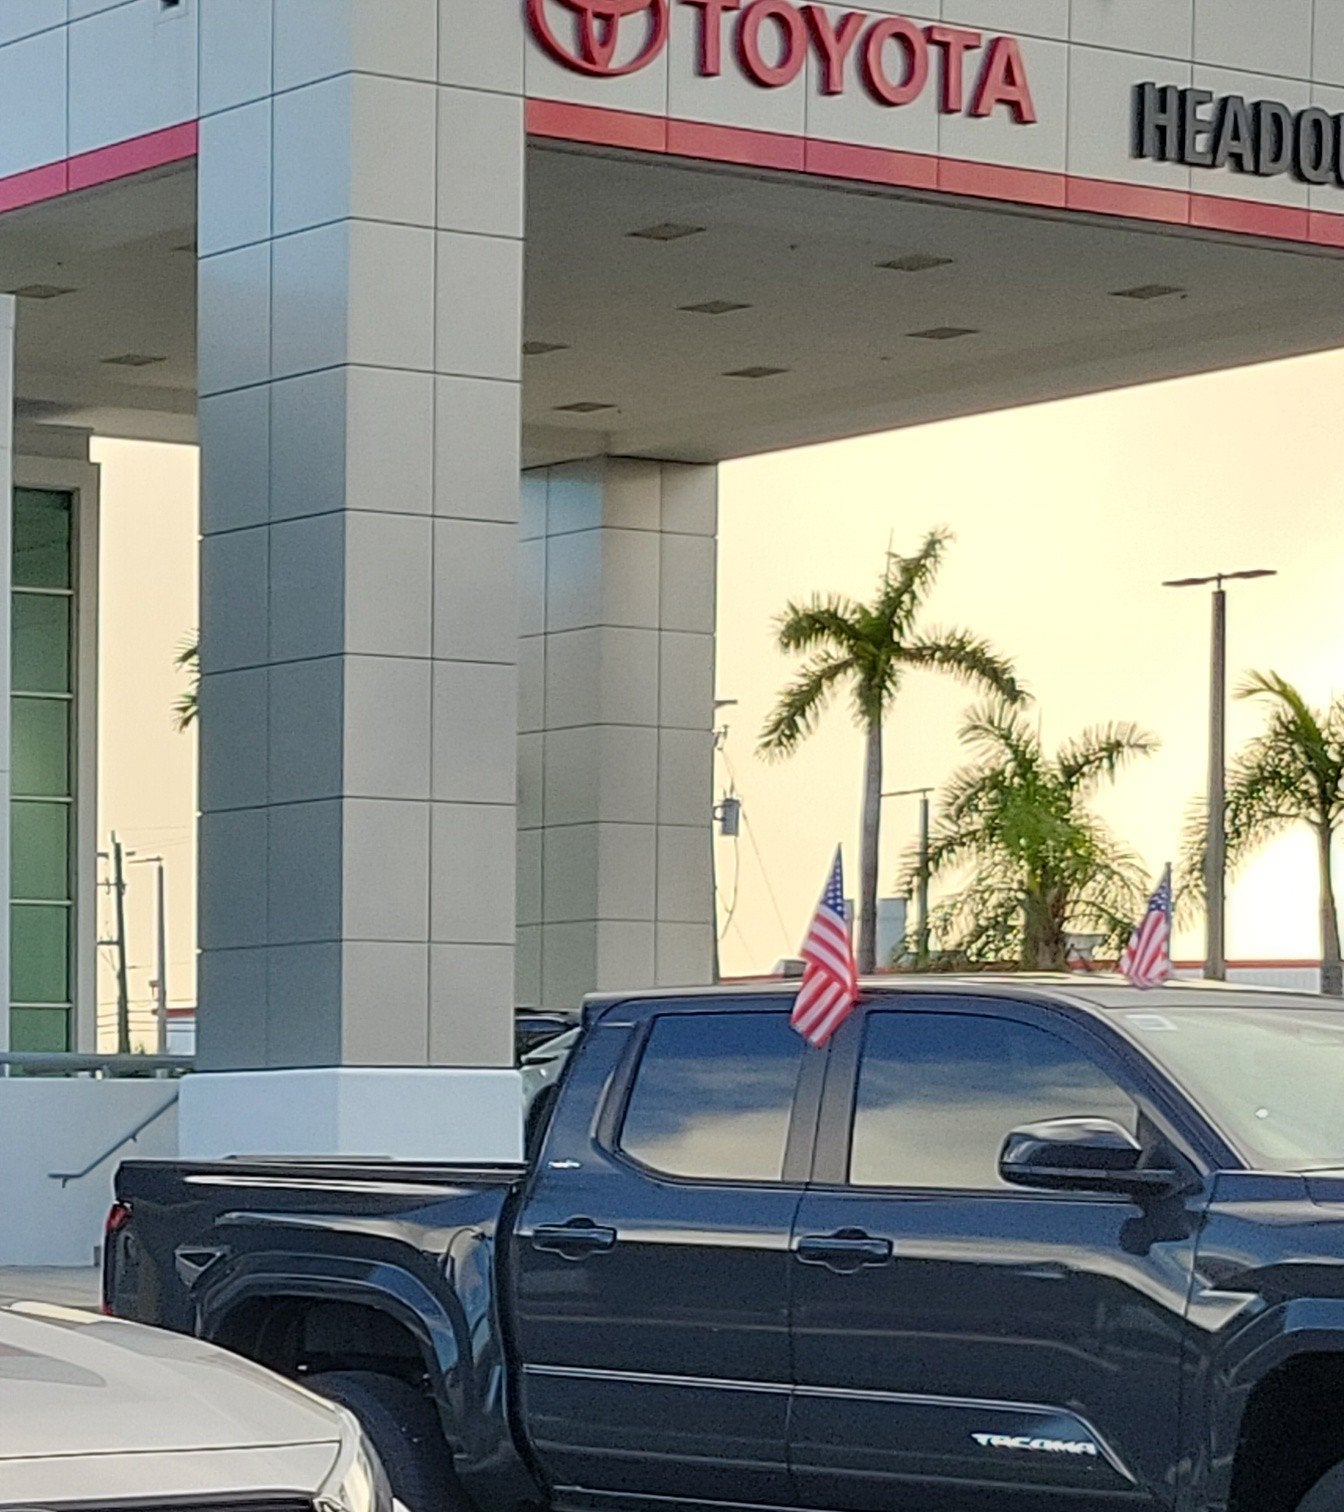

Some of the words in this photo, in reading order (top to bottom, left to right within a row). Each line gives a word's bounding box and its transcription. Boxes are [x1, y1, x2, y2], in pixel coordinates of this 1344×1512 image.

[681, 0, 1036, 124] TOYOTA
[1130, 82, 1344, 188] HEADQ
[970, 1432, 1098, 1456] TACOMA
